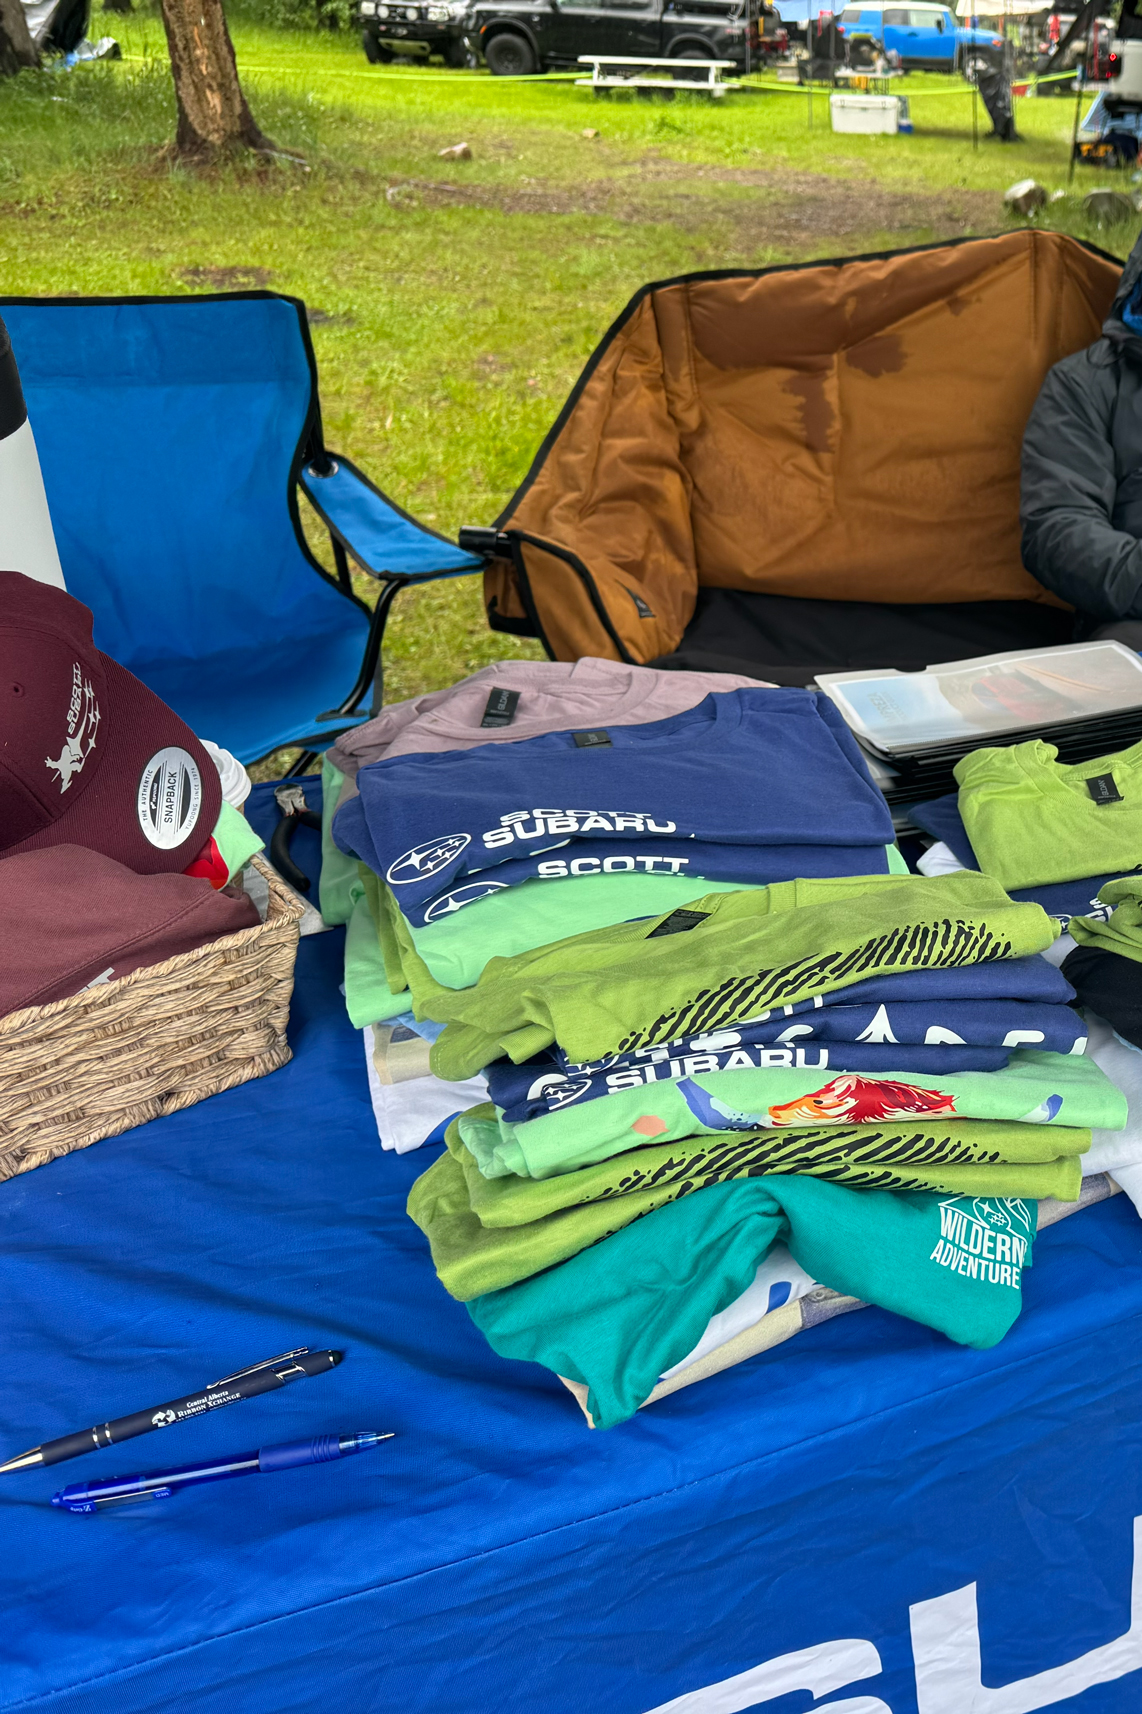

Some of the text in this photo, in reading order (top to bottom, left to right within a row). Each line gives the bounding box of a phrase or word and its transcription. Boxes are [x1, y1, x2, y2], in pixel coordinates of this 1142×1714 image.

[141, 769, 153, 805] AUTHENTIC
[164, 771, 177, 823] SNAPBACK
[482, 815, 677, 849] SUBARU
[499, 808, 652, 827] SCOTT
[537, 855, 690, 879] SCOTT
[605, 1048, 829, 1095] SUBARU
[939, 1206, 1026, 1269] WILDERN
[929, 1238, 1021, 1290] ADVENTURE
[177, 1403, 207, 1418] RIBBON
[207, 1392, 241, 1408] XCHANGE
[186, 1396, 208, 1409] Central
[208, 1390, 229, 1401] Alberta
